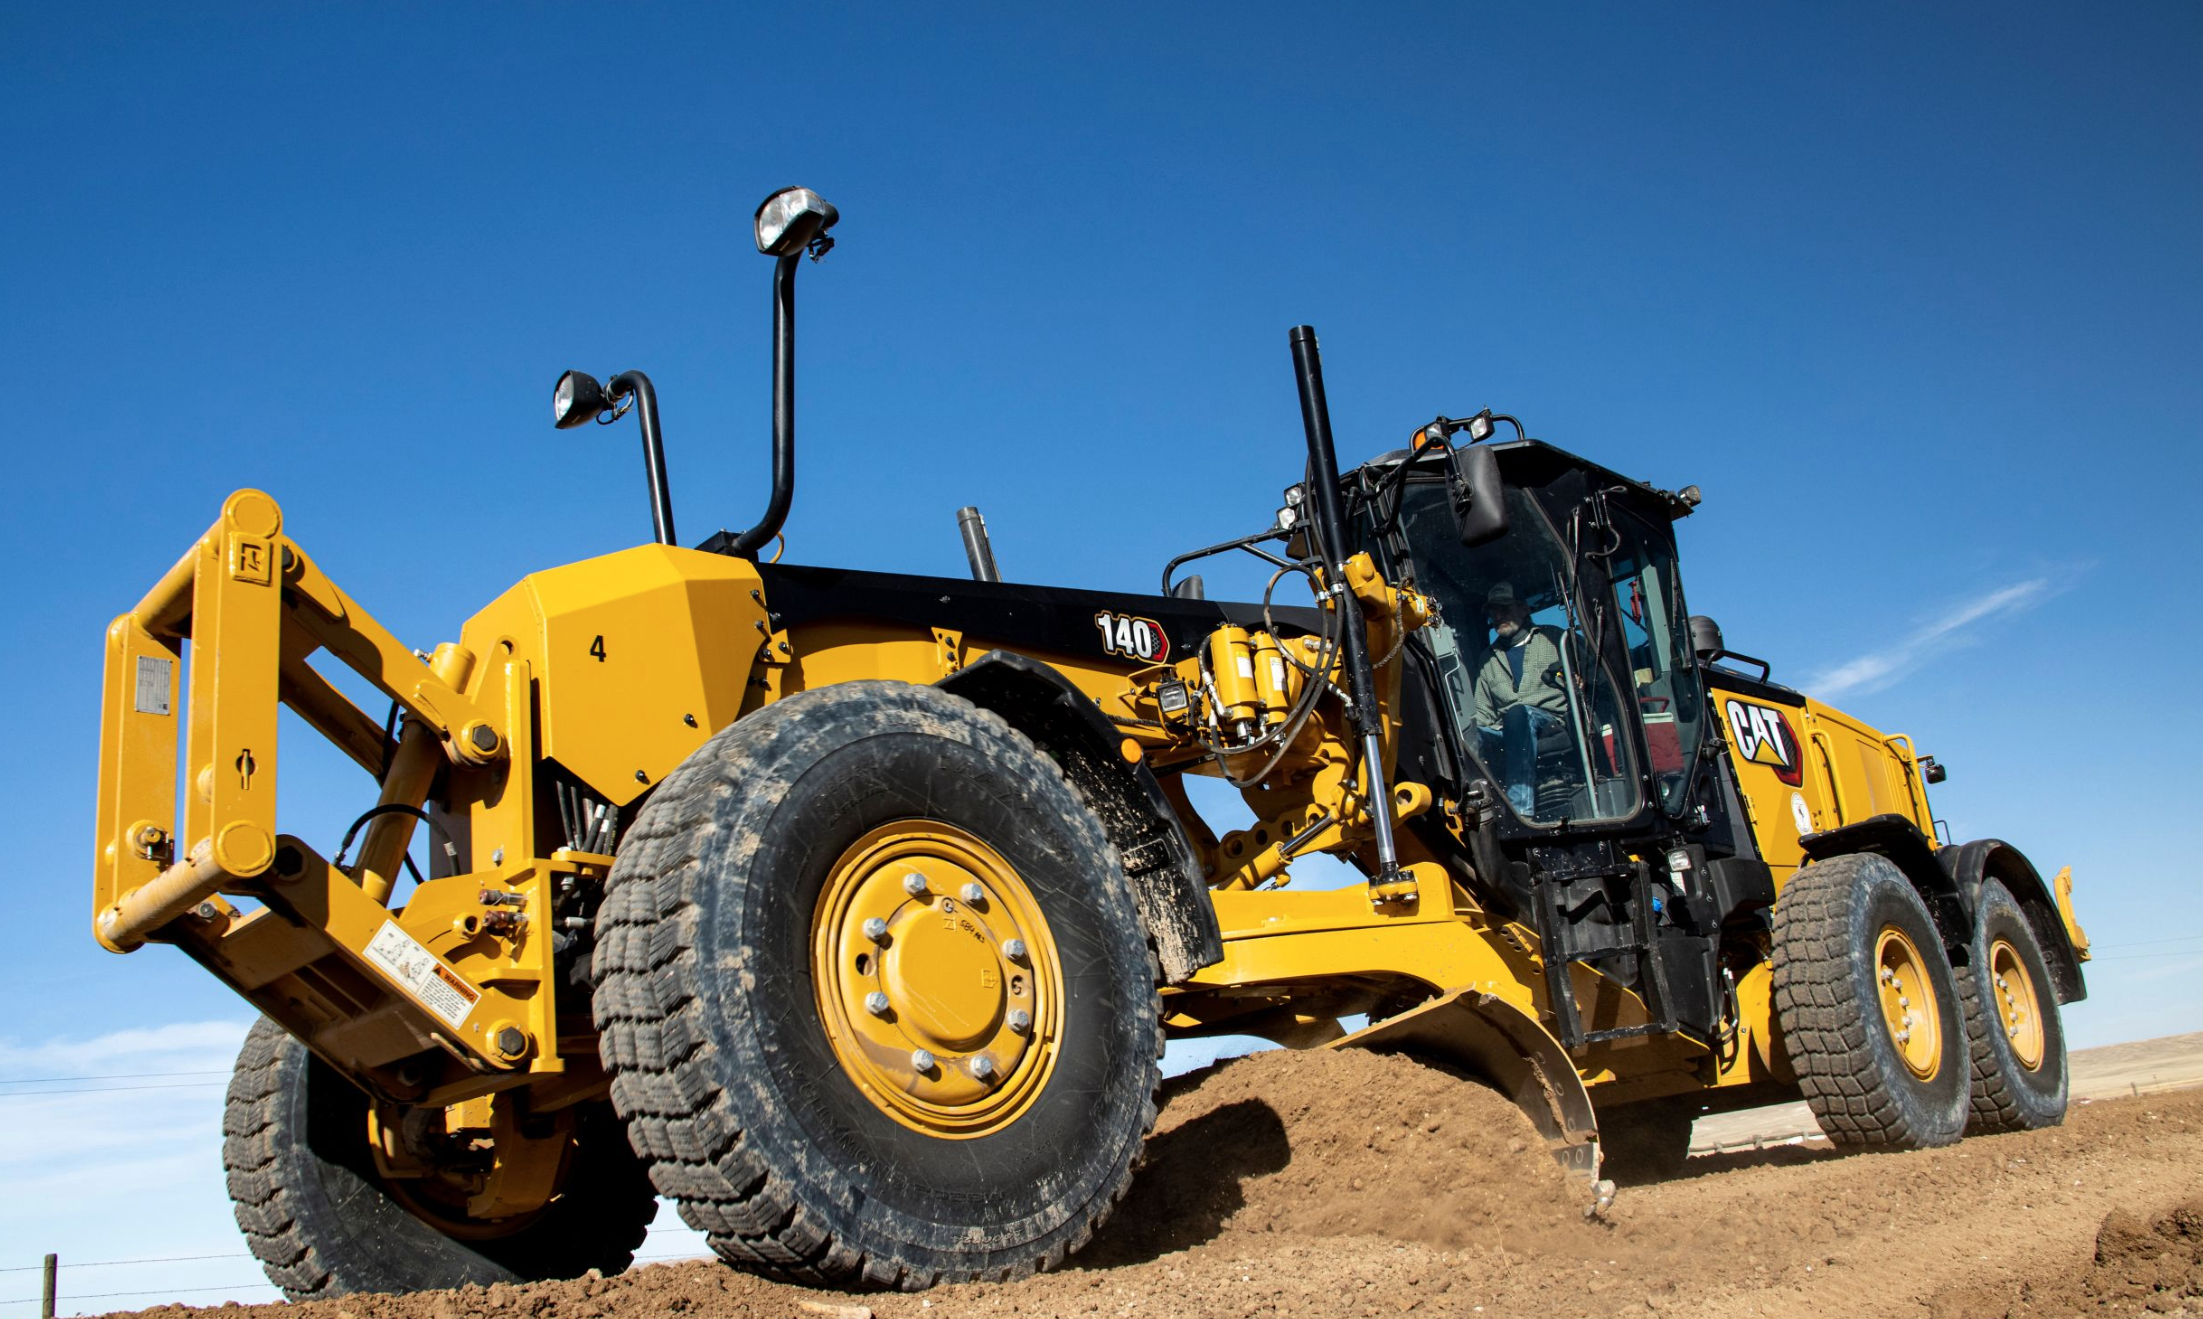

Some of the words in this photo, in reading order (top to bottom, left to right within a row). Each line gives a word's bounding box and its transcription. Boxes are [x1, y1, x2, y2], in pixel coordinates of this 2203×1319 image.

[590, 635, 607, 663] 4
[1098, 614, 1152, 659] 140
[1727, 700, 1790, 766] CAT
[444, 973, 475, 1001] WARNING
